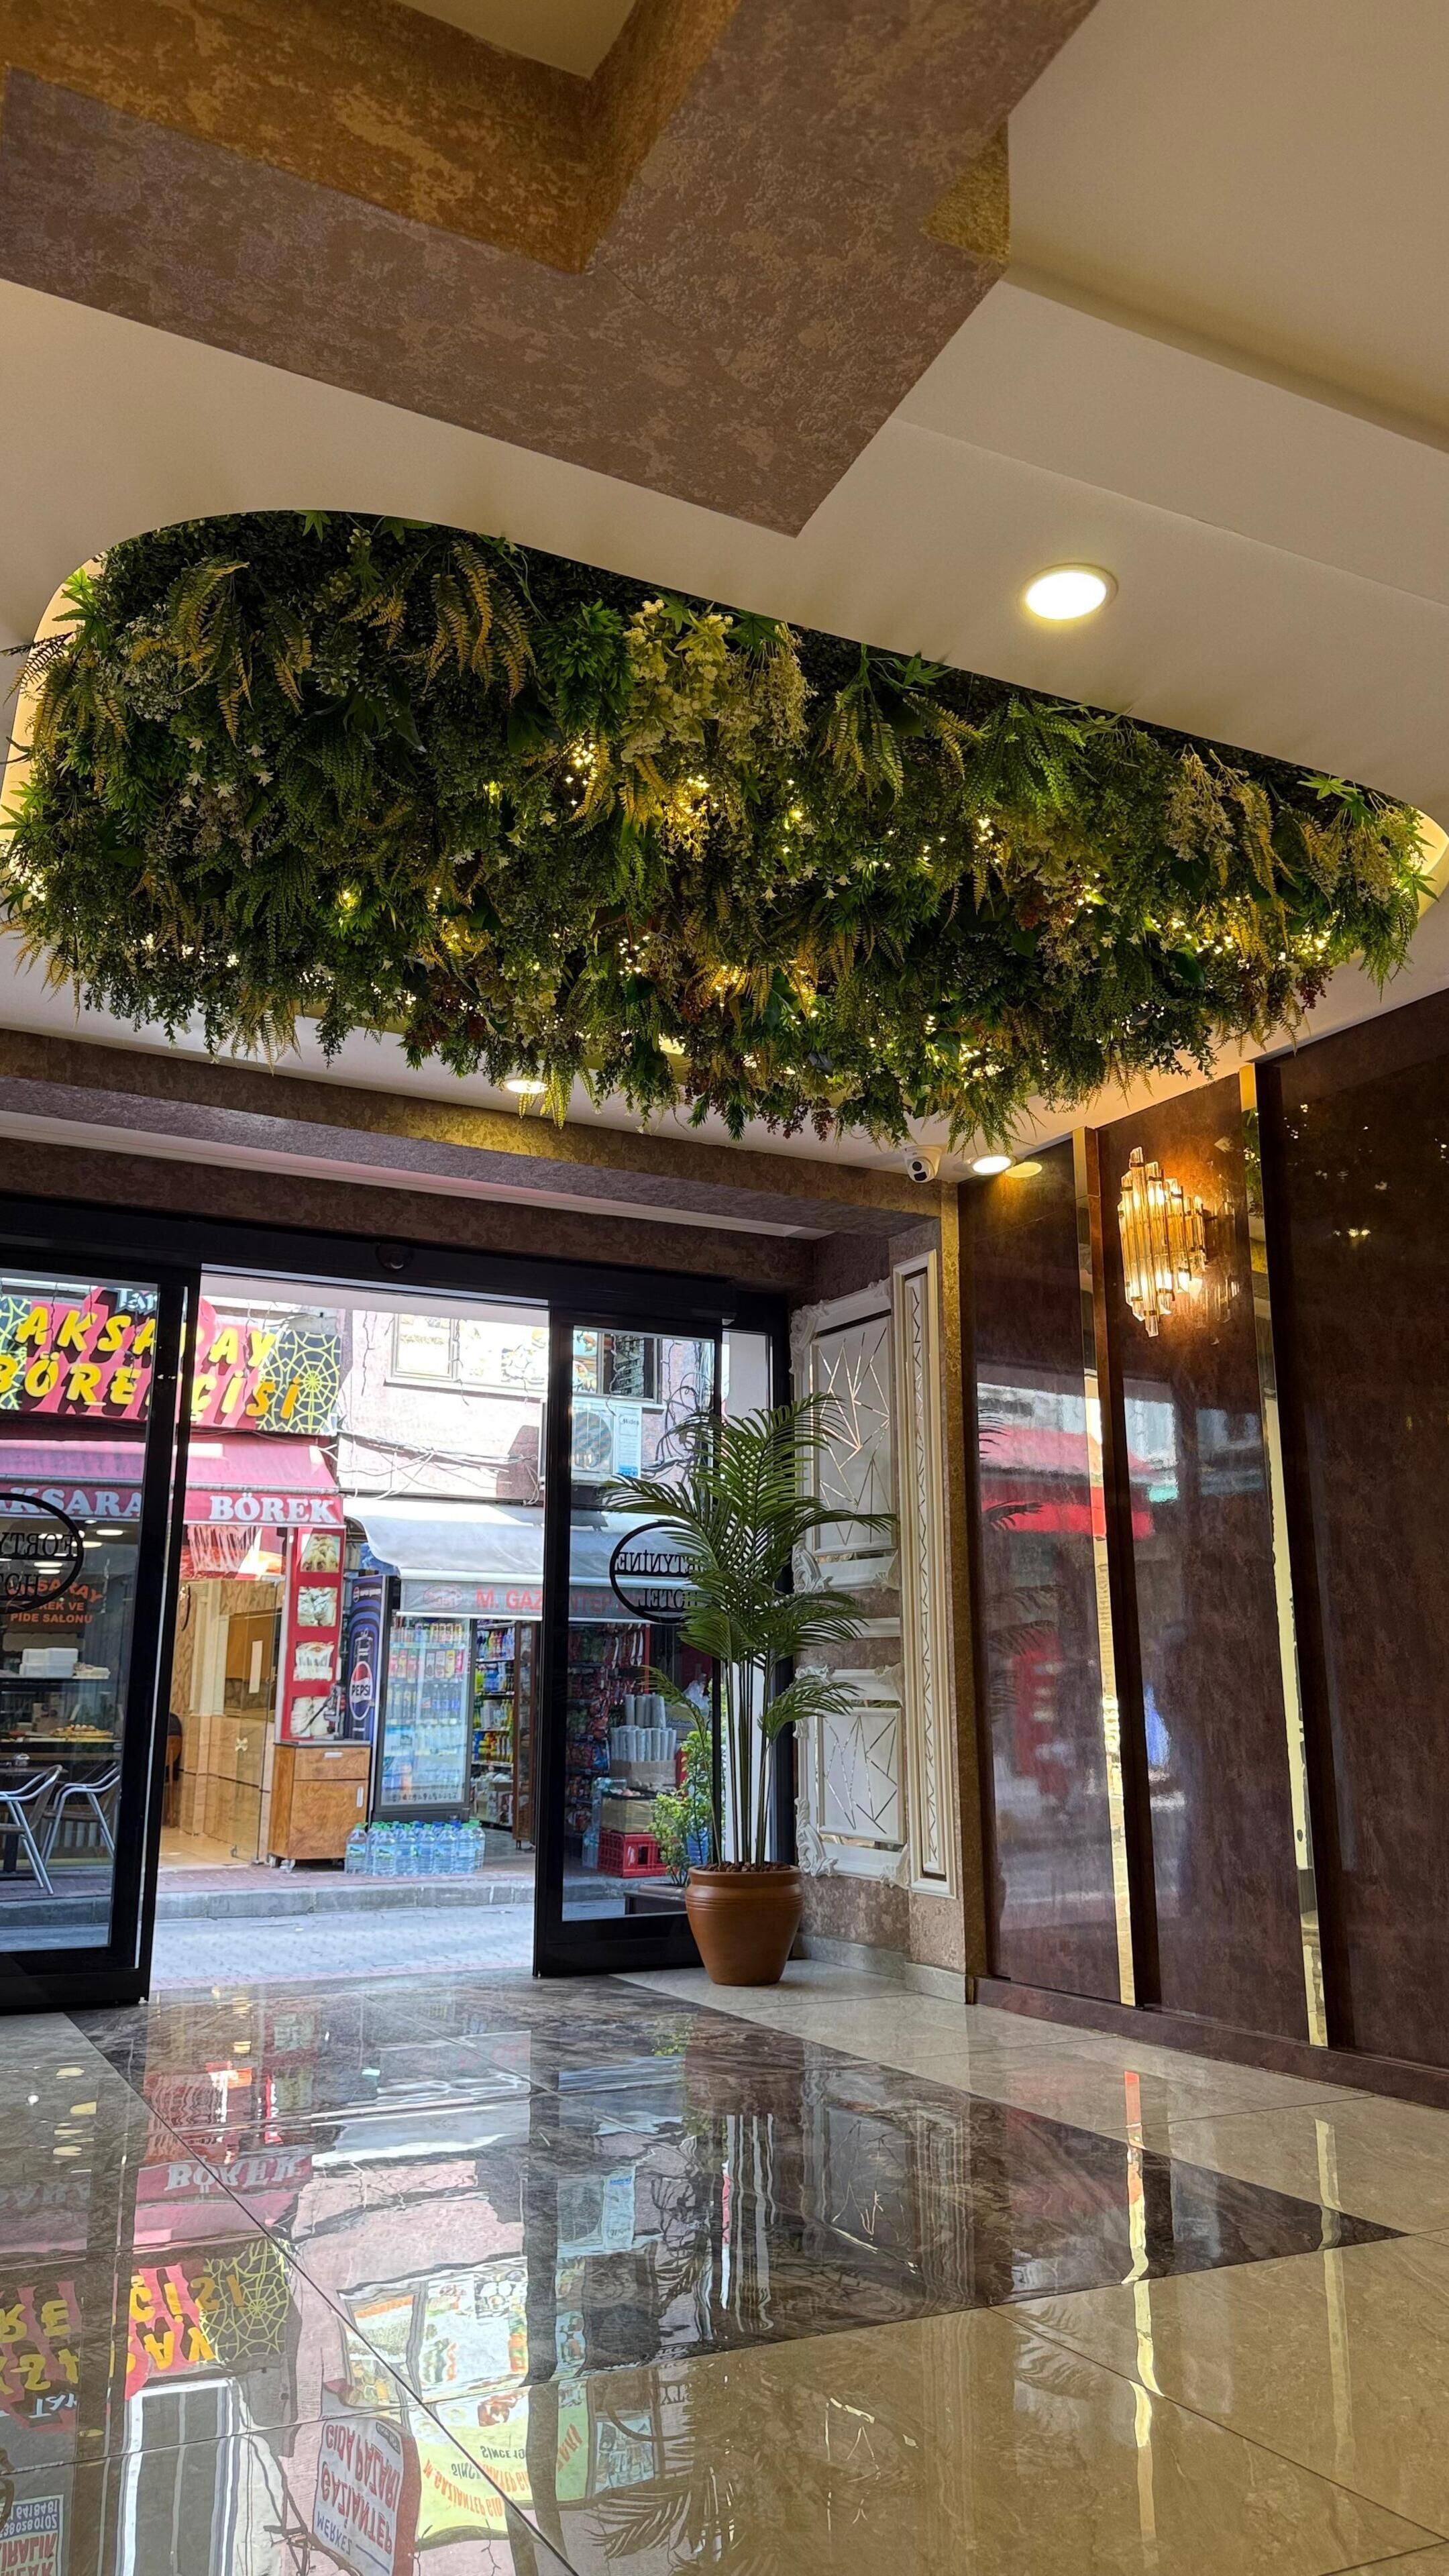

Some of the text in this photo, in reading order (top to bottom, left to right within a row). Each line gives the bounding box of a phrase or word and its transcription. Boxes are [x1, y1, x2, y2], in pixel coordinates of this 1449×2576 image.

[0, 1351, 301, 1421] BÖREÇİSİ
[209, 1492, 337, 1524] BÖREK
[68, 1602, 85, 1611] VE
[42, 1613, 93, 1624] SALONU
[351, 1684, 371, 1697] PEPSI
